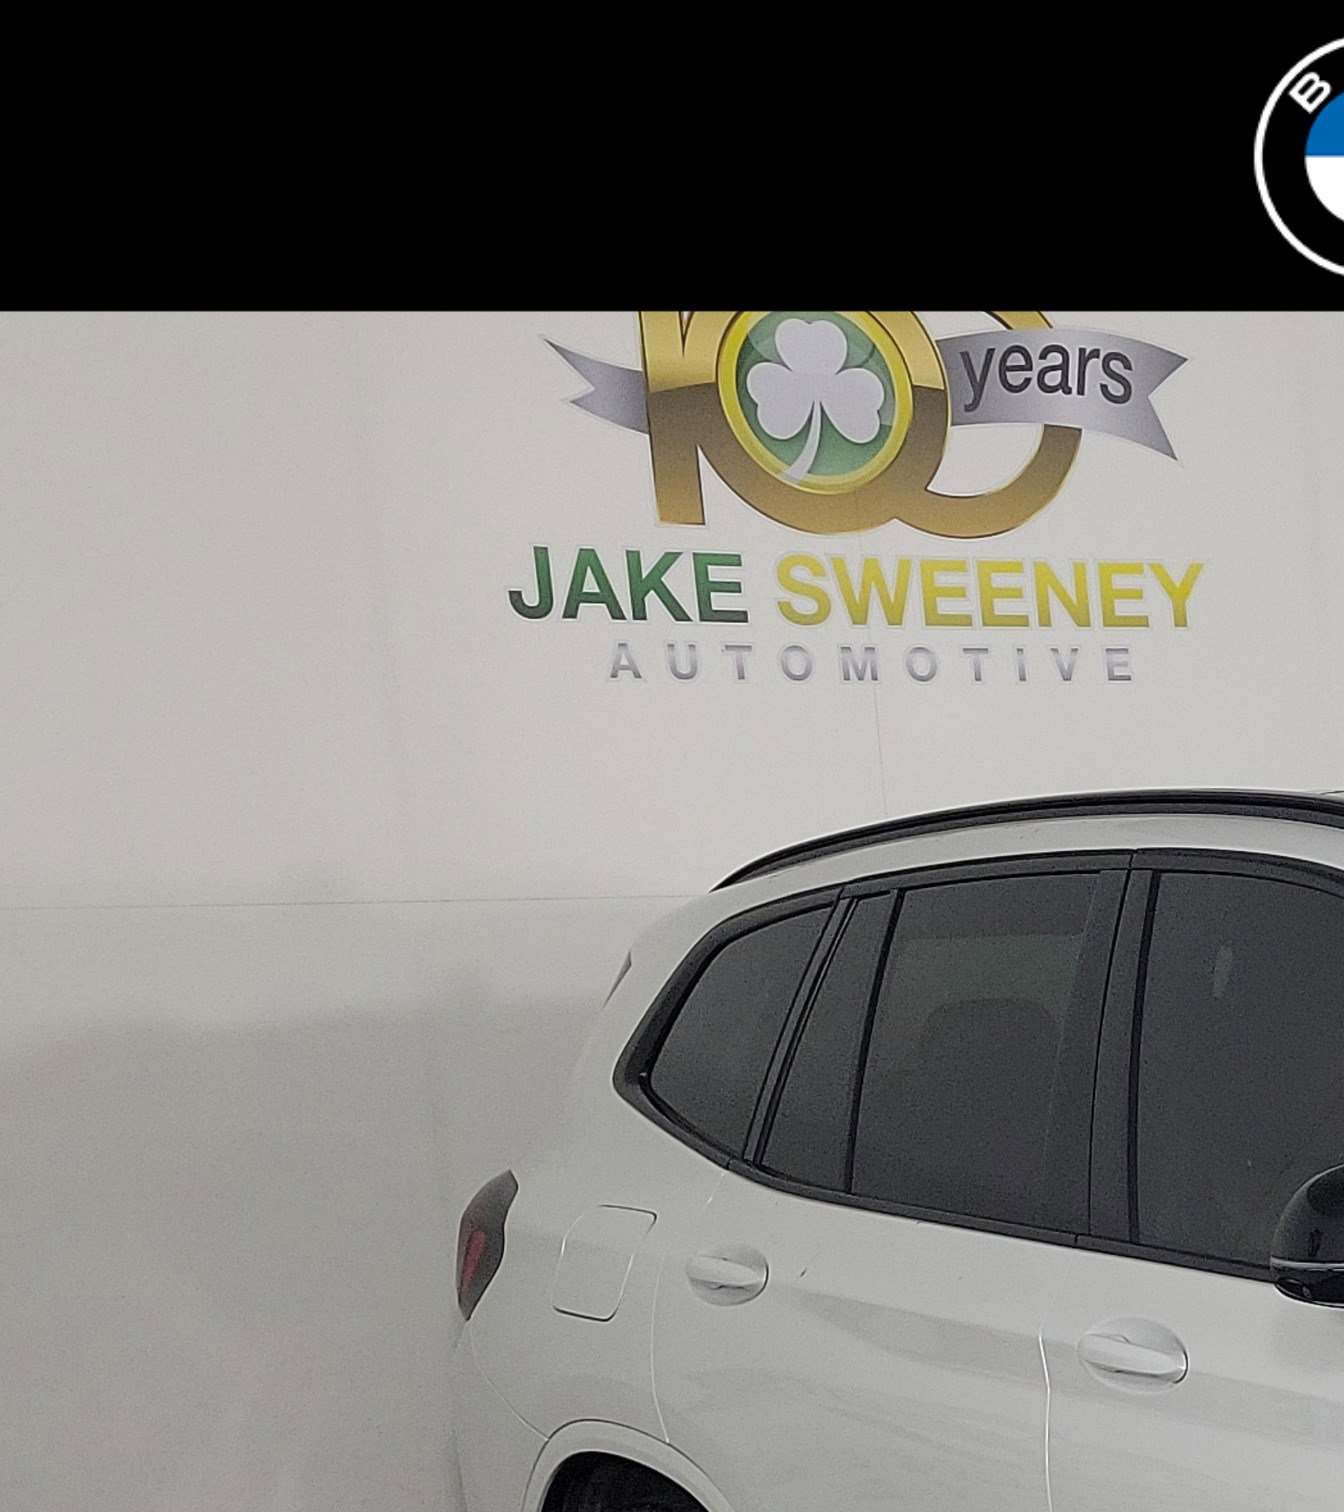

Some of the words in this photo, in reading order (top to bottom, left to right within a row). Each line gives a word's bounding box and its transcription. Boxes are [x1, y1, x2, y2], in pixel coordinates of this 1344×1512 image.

[959, 342, 1135, 412] years
[507, 545, 750, 624] JAKE
[775, 555, 1205, 629] SWEENEY
[609, 641, 1132, 683] AUTOMOTIVE
